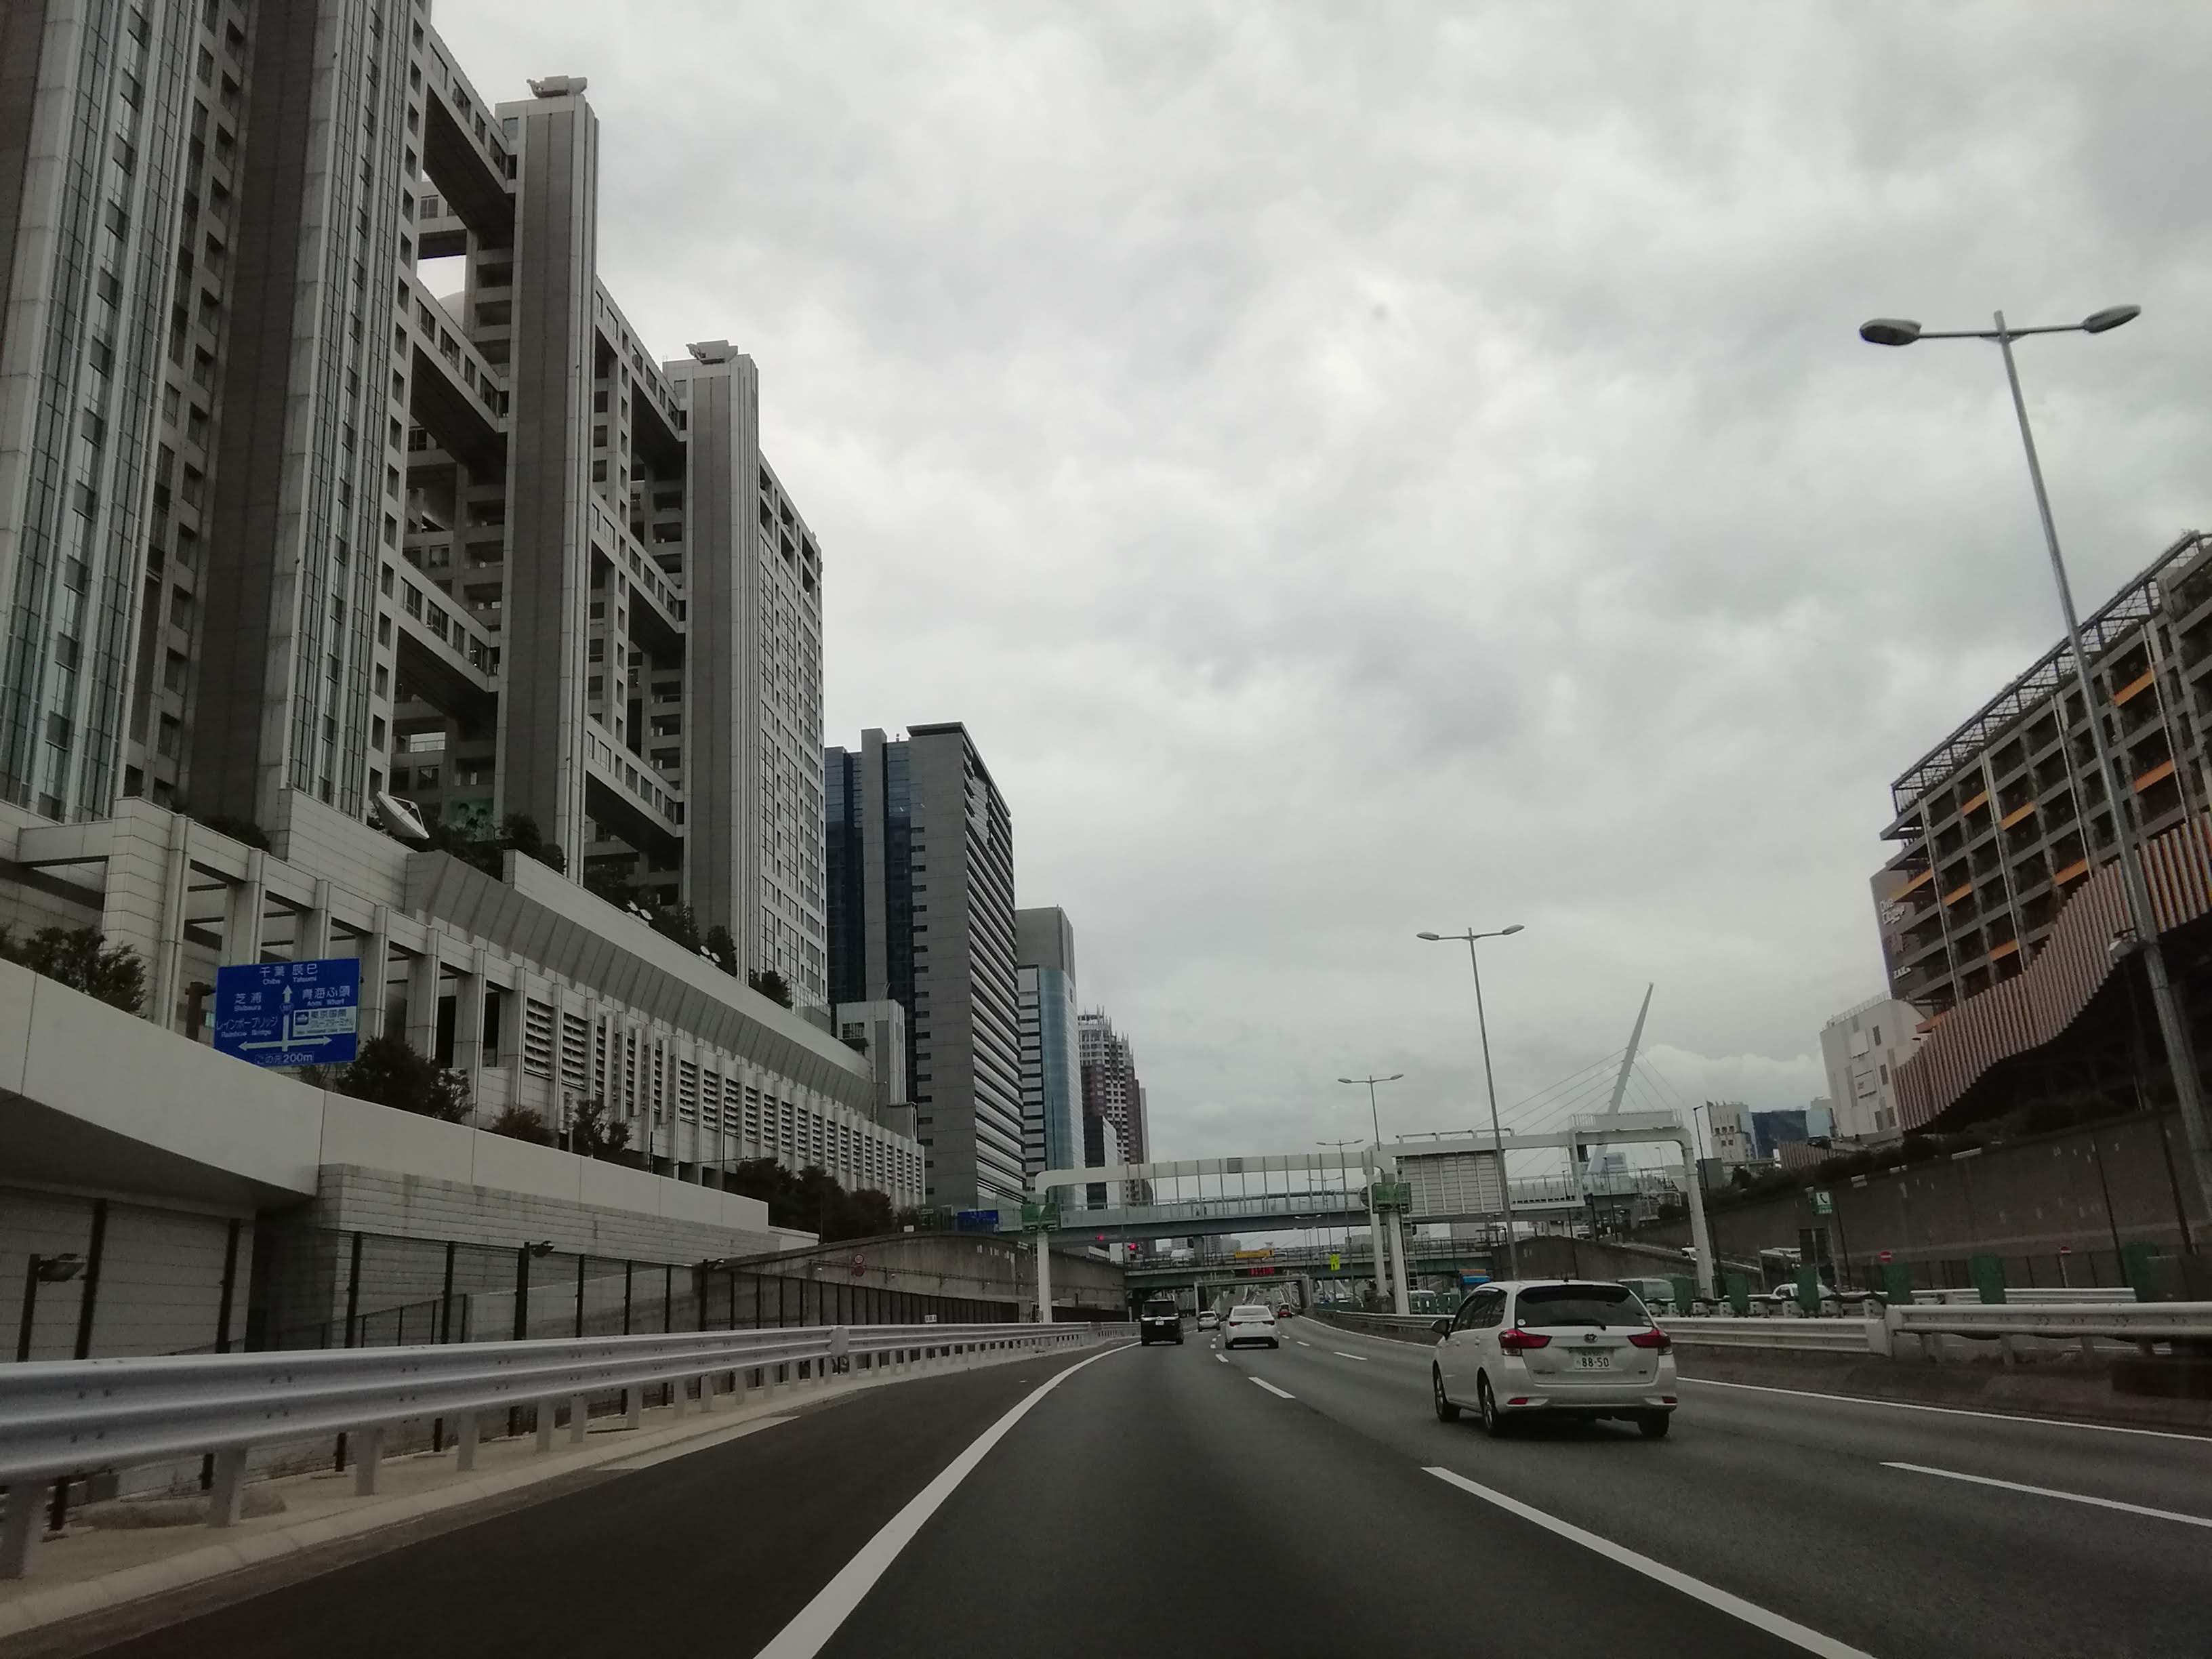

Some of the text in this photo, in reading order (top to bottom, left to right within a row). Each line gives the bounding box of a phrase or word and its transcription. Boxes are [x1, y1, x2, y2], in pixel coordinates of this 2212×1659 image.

[260, 964, 318, 977] 千葉 辰巳
[235, 986, 350, 1004] 芝浦 青海ふ頭
